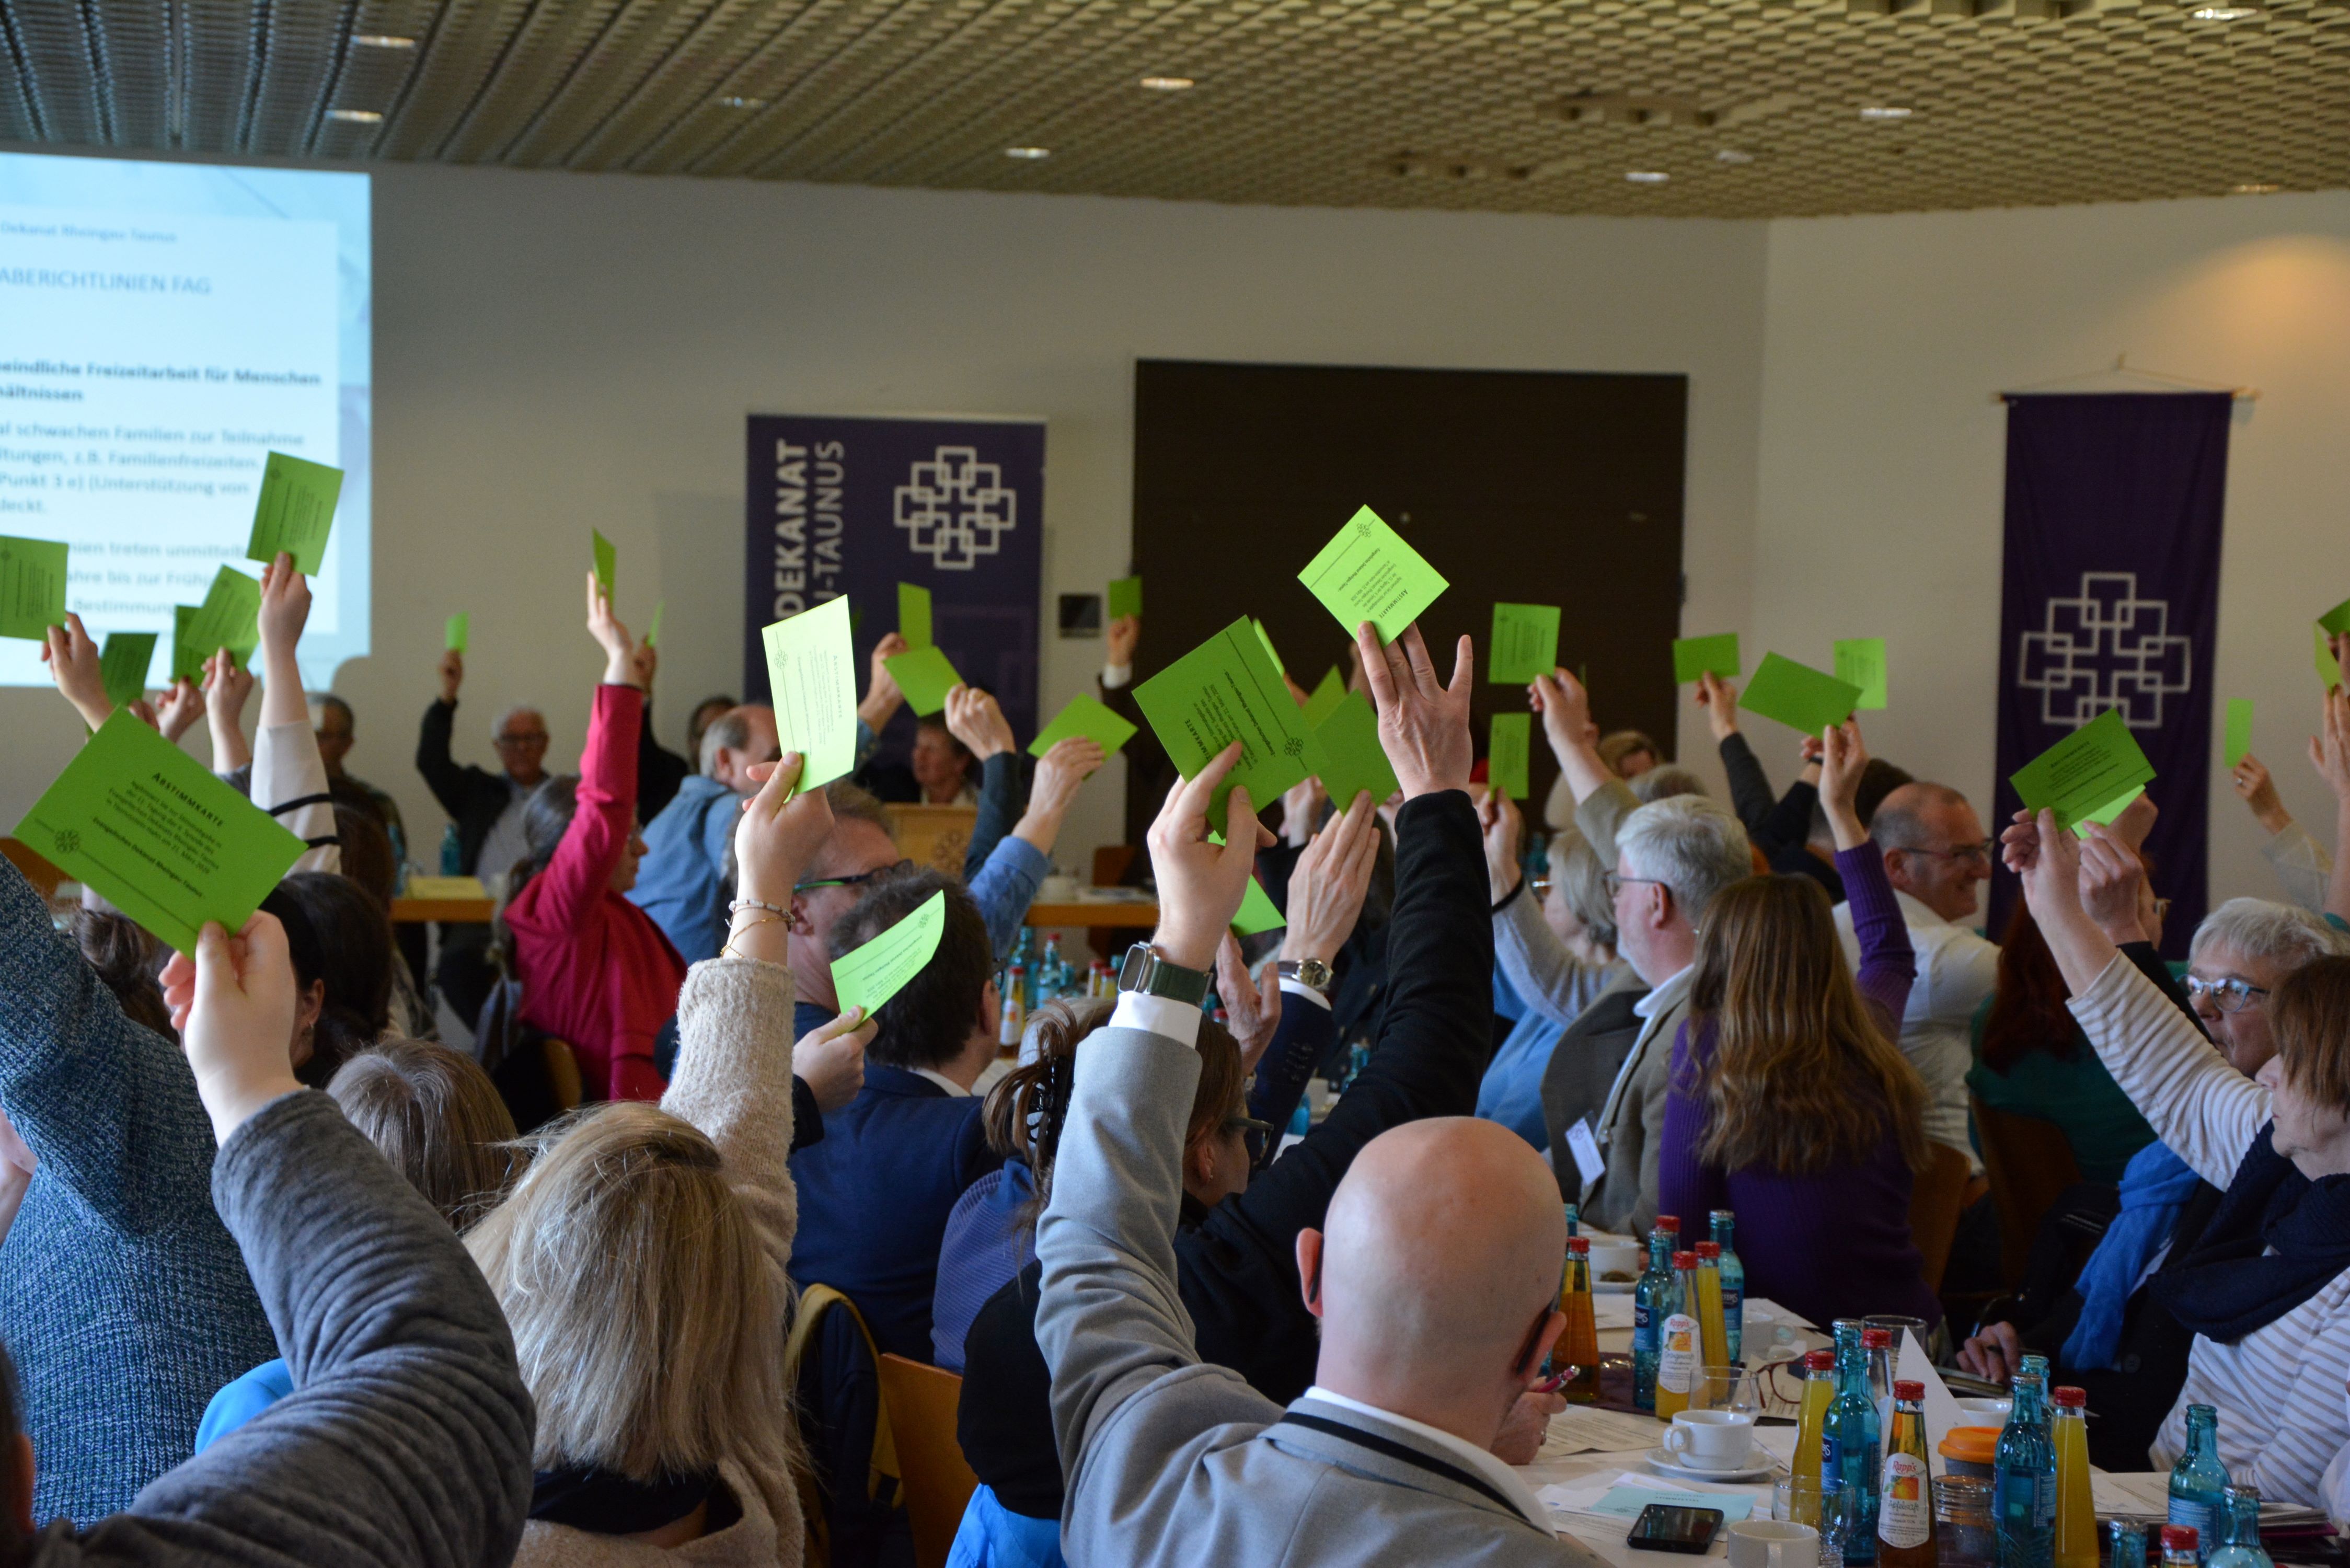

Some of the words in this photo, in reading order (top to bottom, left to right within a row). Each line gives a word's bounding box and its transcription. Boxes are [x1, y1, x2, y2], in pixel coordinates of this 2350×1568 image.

[172, 274, 211, 295] FAG
[0, 359, 80, 375] eindliche
[87, 361, 199, 382] Freizeitarbeit
[205, 367, 227, 383] für
[234, 368, 320, 386] Menschen
[16, 422, 109, 440] schwachen
[115, 425, 183, 445] Familien
[190, 431, 214, 445] zur
[221, 429, 303, 447] Teilnahme
[218, 482, 249, 494] von
[774, 438, 808, 620] DEKANAT
[1378, 588, 1408, 619] ABSTIMMKARTE
[1184, 718, 1213, 763] STIMMKARTE
[151, 771, 225, 826] ABSTIMMKARTE
[1892, 1461, 1917, 1474] Rapp's
